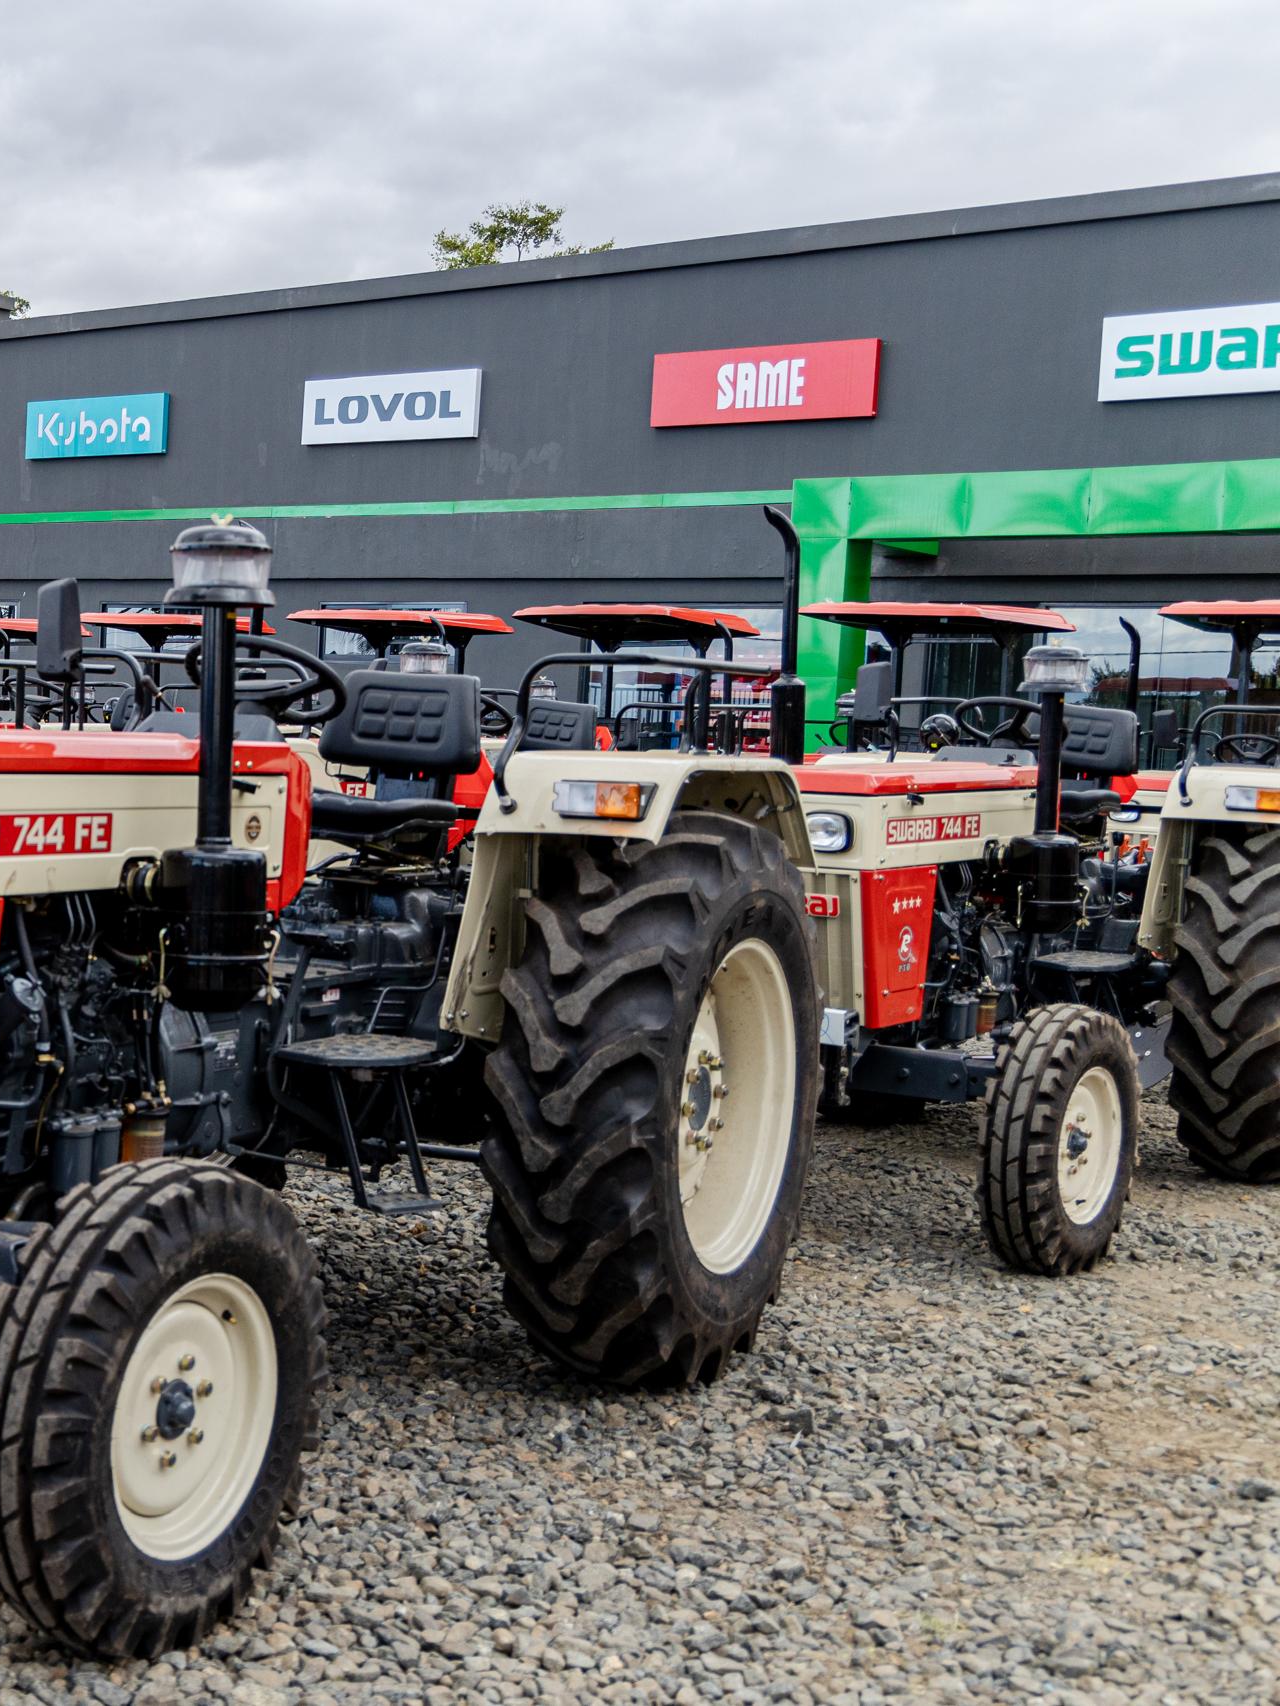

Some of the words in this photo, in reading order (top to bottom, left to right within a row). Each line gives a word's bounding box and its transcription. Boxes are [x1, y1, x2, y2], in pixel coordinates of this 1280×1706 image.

[716, 359, 806, 410] SAME
[37, 408, 151, 446] Kubota
[314, 391, 461, 425] LOVOL
[12, 816, 65, 854] 744
[74, 815, 109, 851] FE
[940, 817, 962, 839] 744
[965, 815, 980, 837] FE
